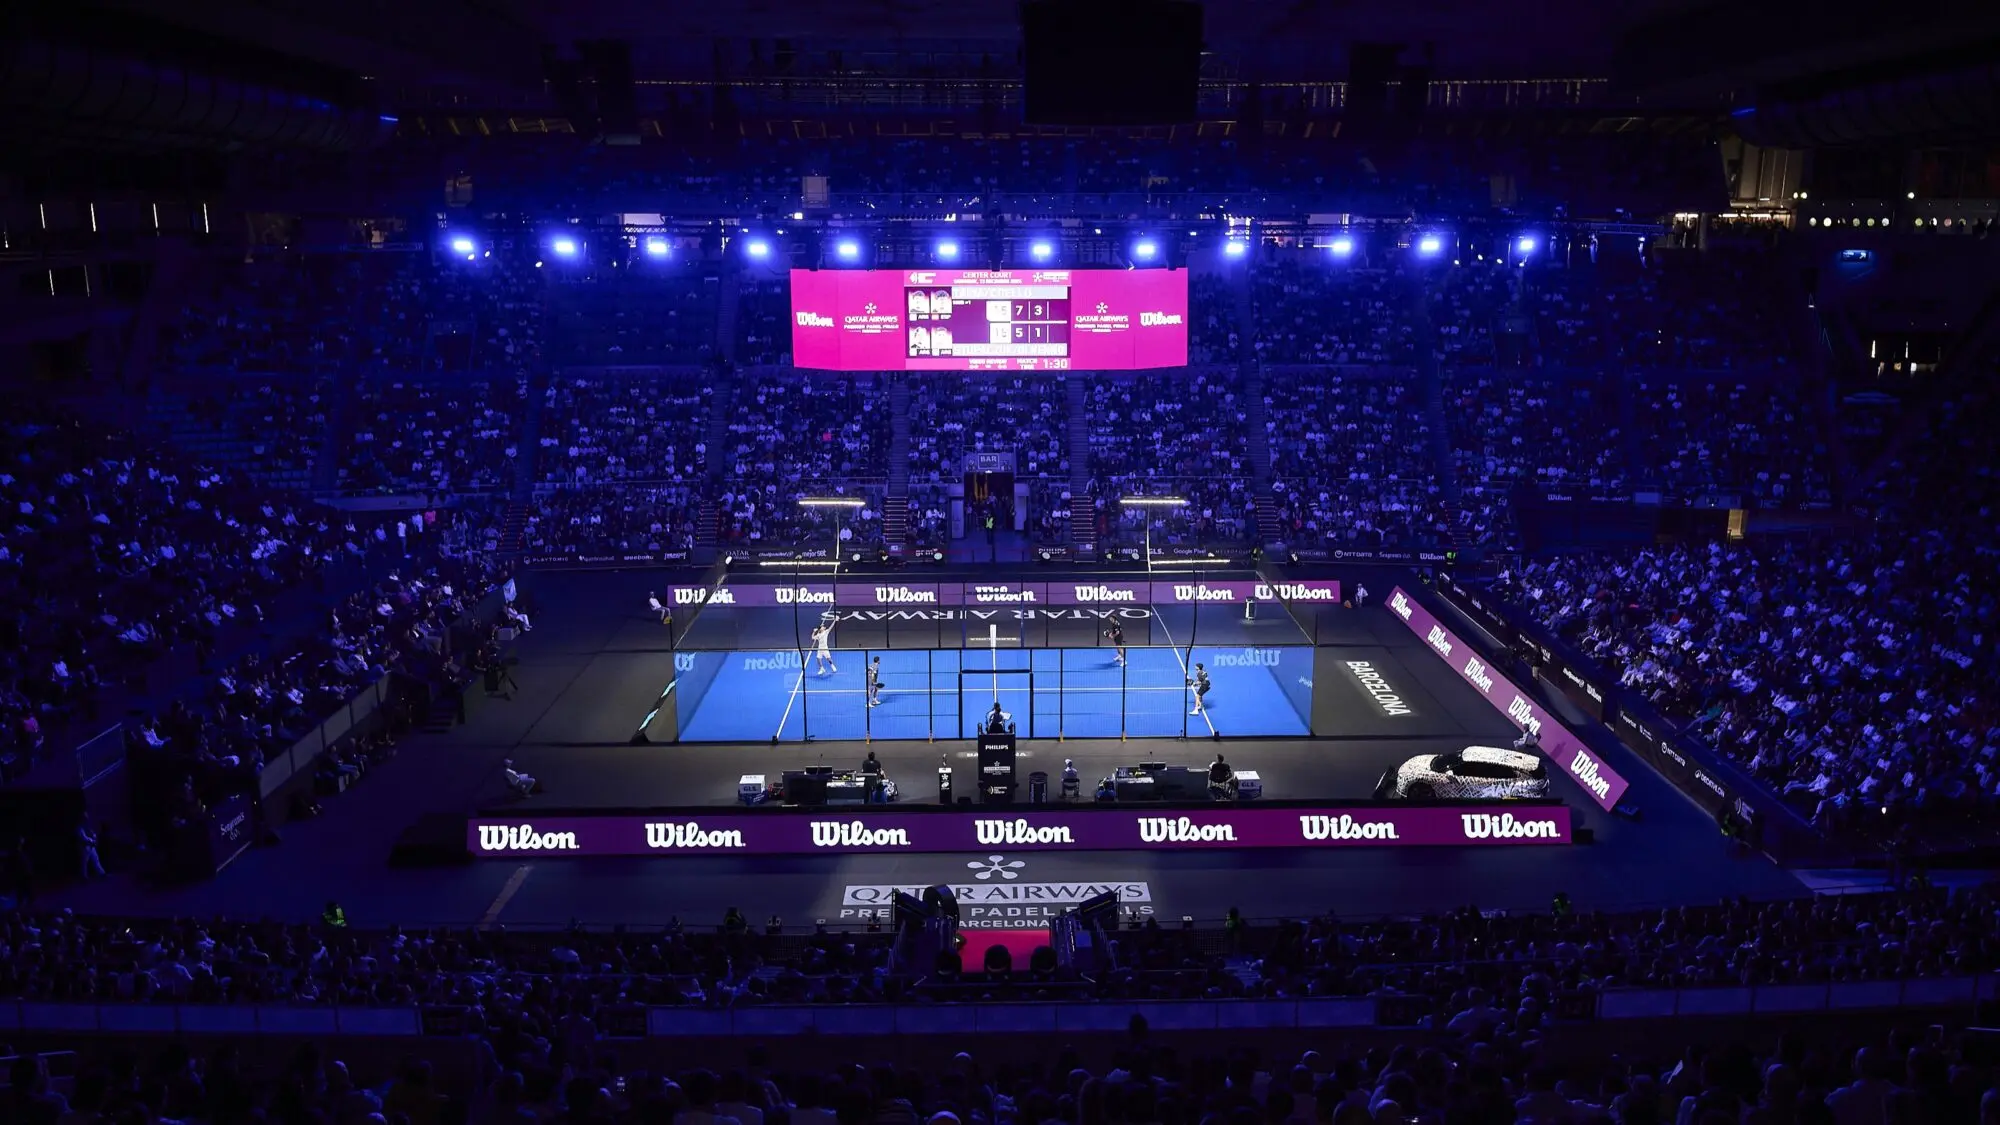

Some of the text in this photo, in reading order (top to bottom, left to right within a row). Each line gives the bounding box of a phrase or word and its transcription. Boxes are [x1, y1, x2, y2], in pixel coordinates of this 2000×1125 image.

[1015, 305, 1024, 316] 7
[1034, 305, 1043, 316] 3
[1075, 315, 1129, 323] QATAR AIRWAYS
[1140, 311, 1182, 326] Wilson
[796, 312, 834, 327] Wilson
[1015, 328, 1023, 338] 5
[1034, 328, 1042, 338] 1
[1043, 359, 1068, 369] 1:30
[1420, 552, 1445, 560] Wilson
[775, 586, 835, 604] Wilson
[875, 586, 936, 603] Wilson
[975, 586, 1036, 602] Wilson
[1075, 585, 1135, 602] Wilson
[1174, 585, 1235, 601] Wilson
[1391, 592, 1413, 620] Wilson
[1428, 625, 1453, 656] Wilson
[1464, 657, 1493, 693] Wilson
[1345, 660, 1412, 716] BARCELONA
[1508, 695, 1542, 736] Wilson
[1571, 750, 1611, 800] Wilson
[1700, 773, 1726, 798] DECATHLON
[811, 821, 911, 846] Wilson
[975, 819, 1074, 844] Wilson
[1138, 817, 1237, 842] Wilson
[1300, 815, 1399, 839] Wilson
[1462, 813, 1560, 838] Wilson
[479, 824, 579, 850] Wilson
[645, 822, 746, 847] Wilson
[971, 906, 1056, 918] PADEL
[957, 919, 1050, 929] ARCELONA
